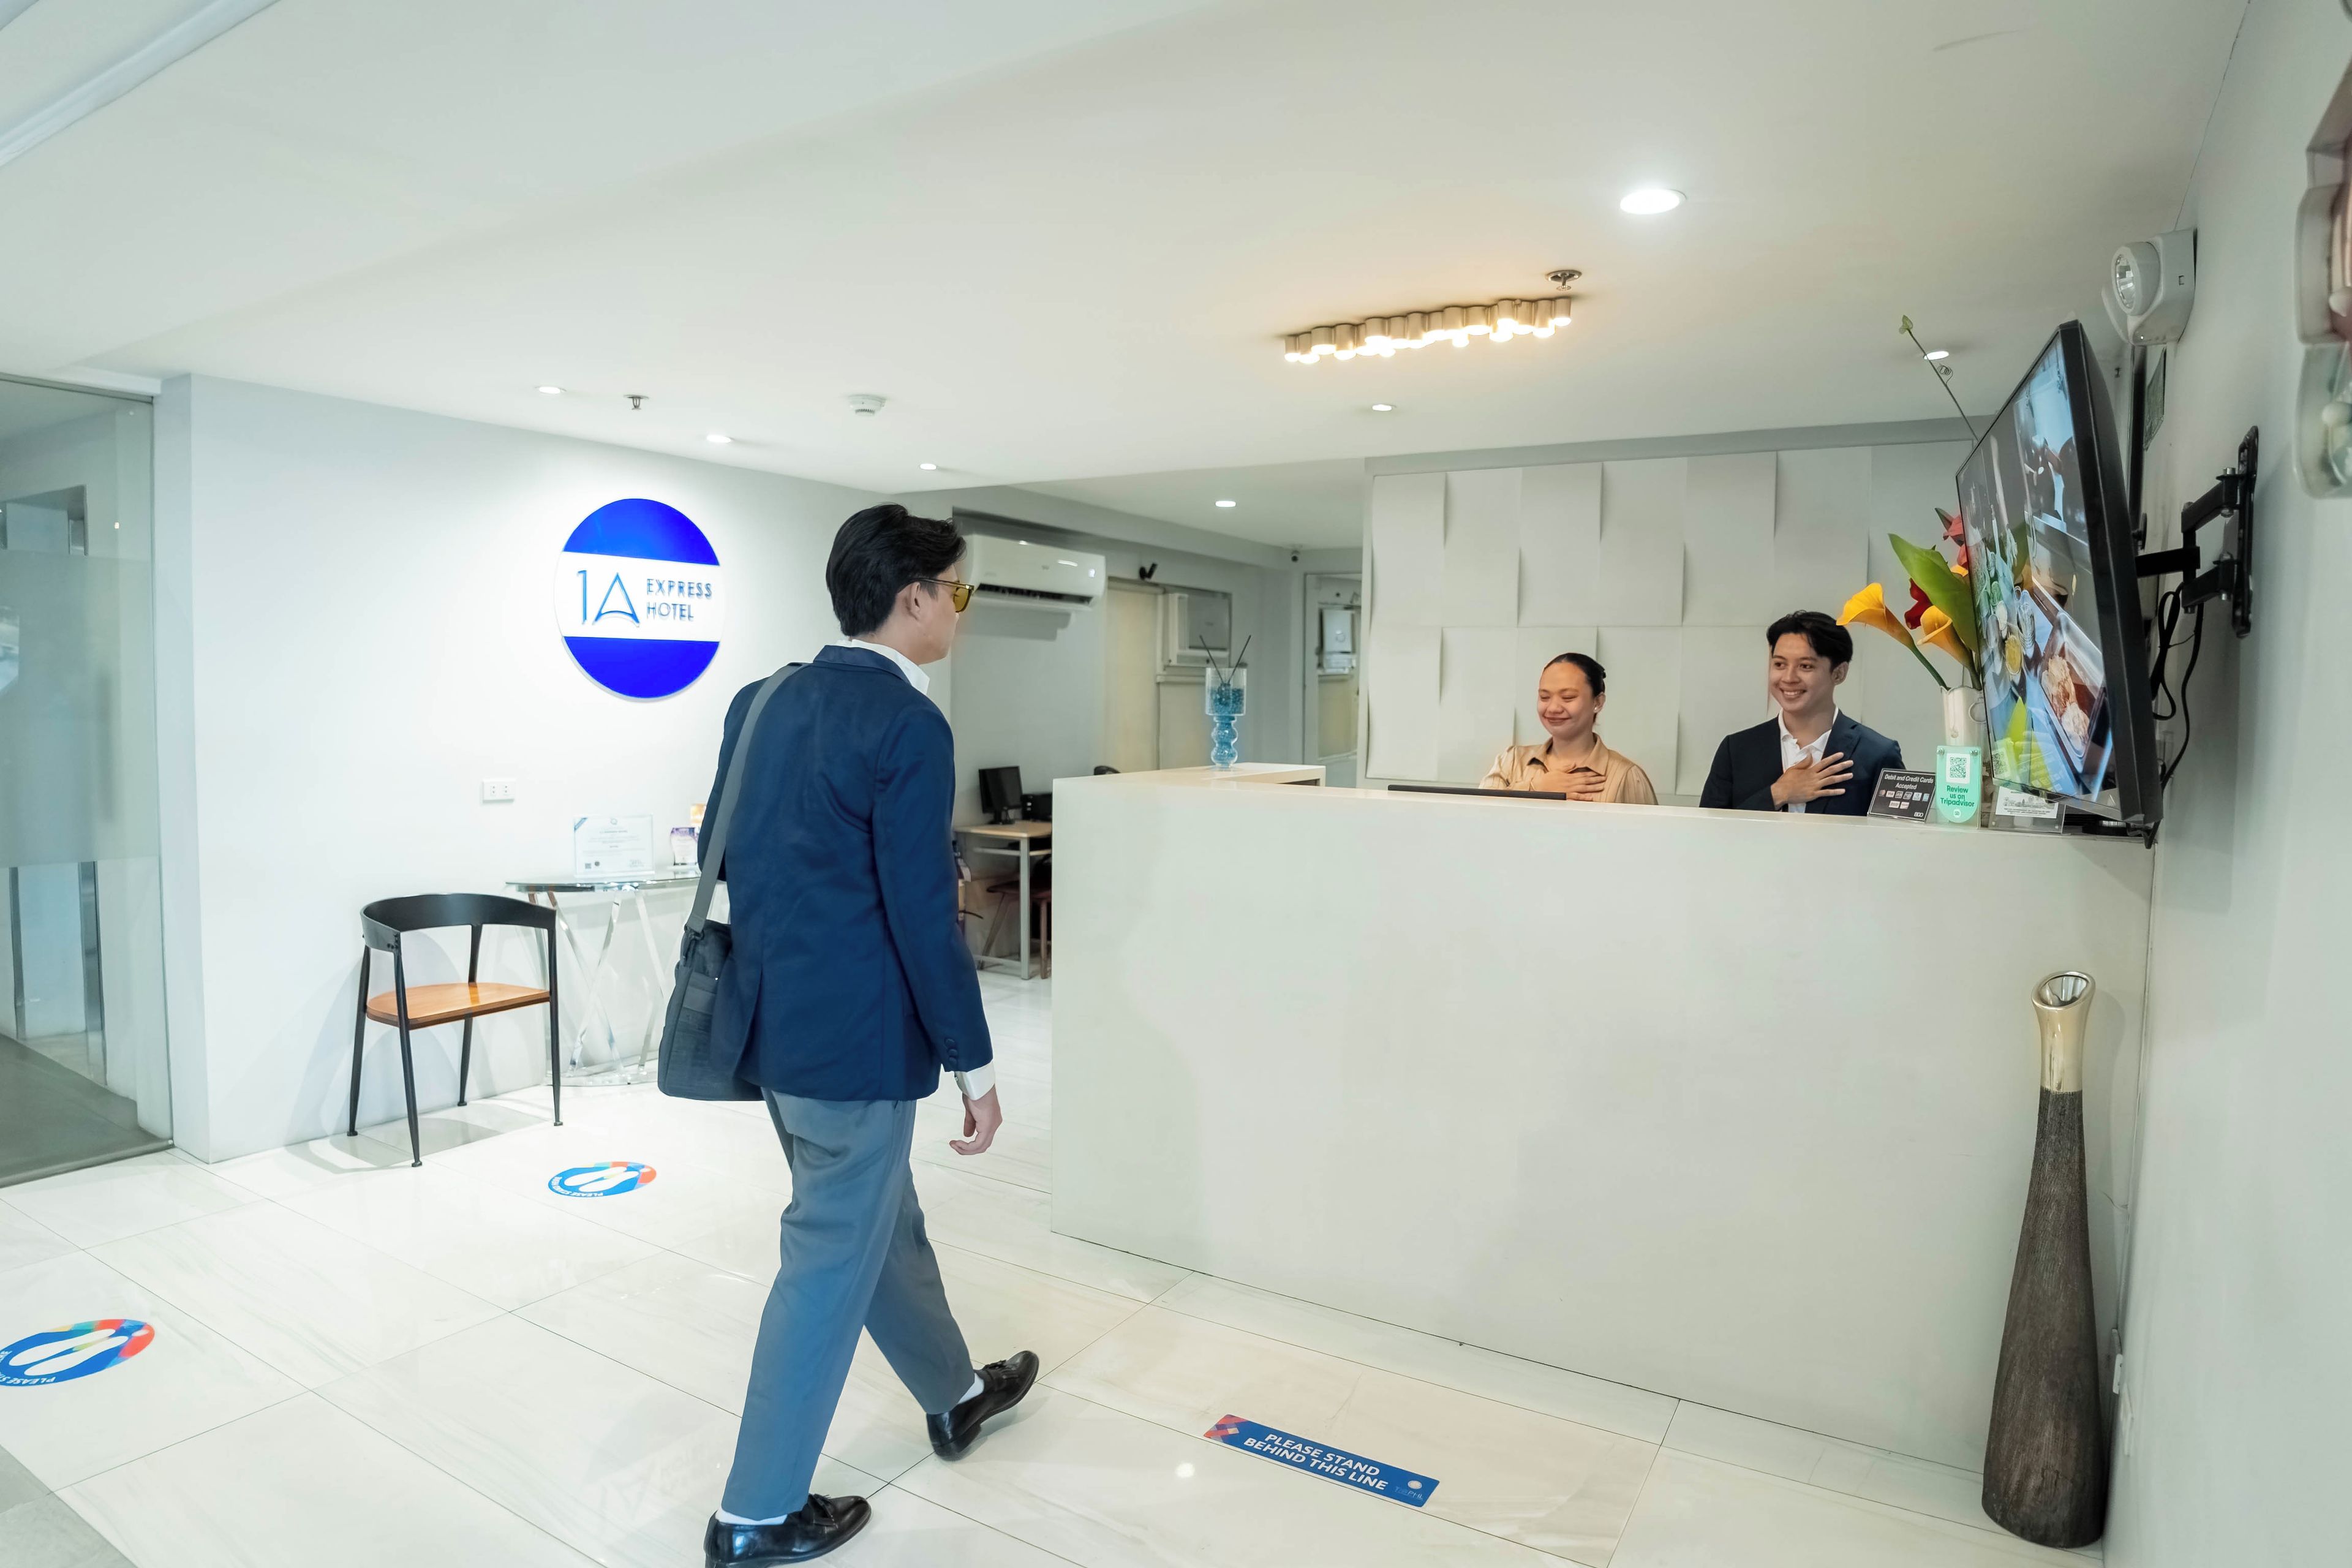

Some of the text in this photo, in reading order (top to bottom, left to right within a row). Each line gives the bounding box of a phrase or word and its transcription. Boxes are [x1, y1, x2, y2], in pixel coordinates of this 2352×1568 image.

[576, 570, 640, 628] 1A
[646, 578, 712, 598] EXPRESS
[646, 602, 695, 622] HOTEL
[1940, 797, 1975, 807] Tripadvisor
[1243, 1438, 1388, 1490] BEHIND THIS LINE
[1265, 1434, 1380, 1476] PLEASE STAND
